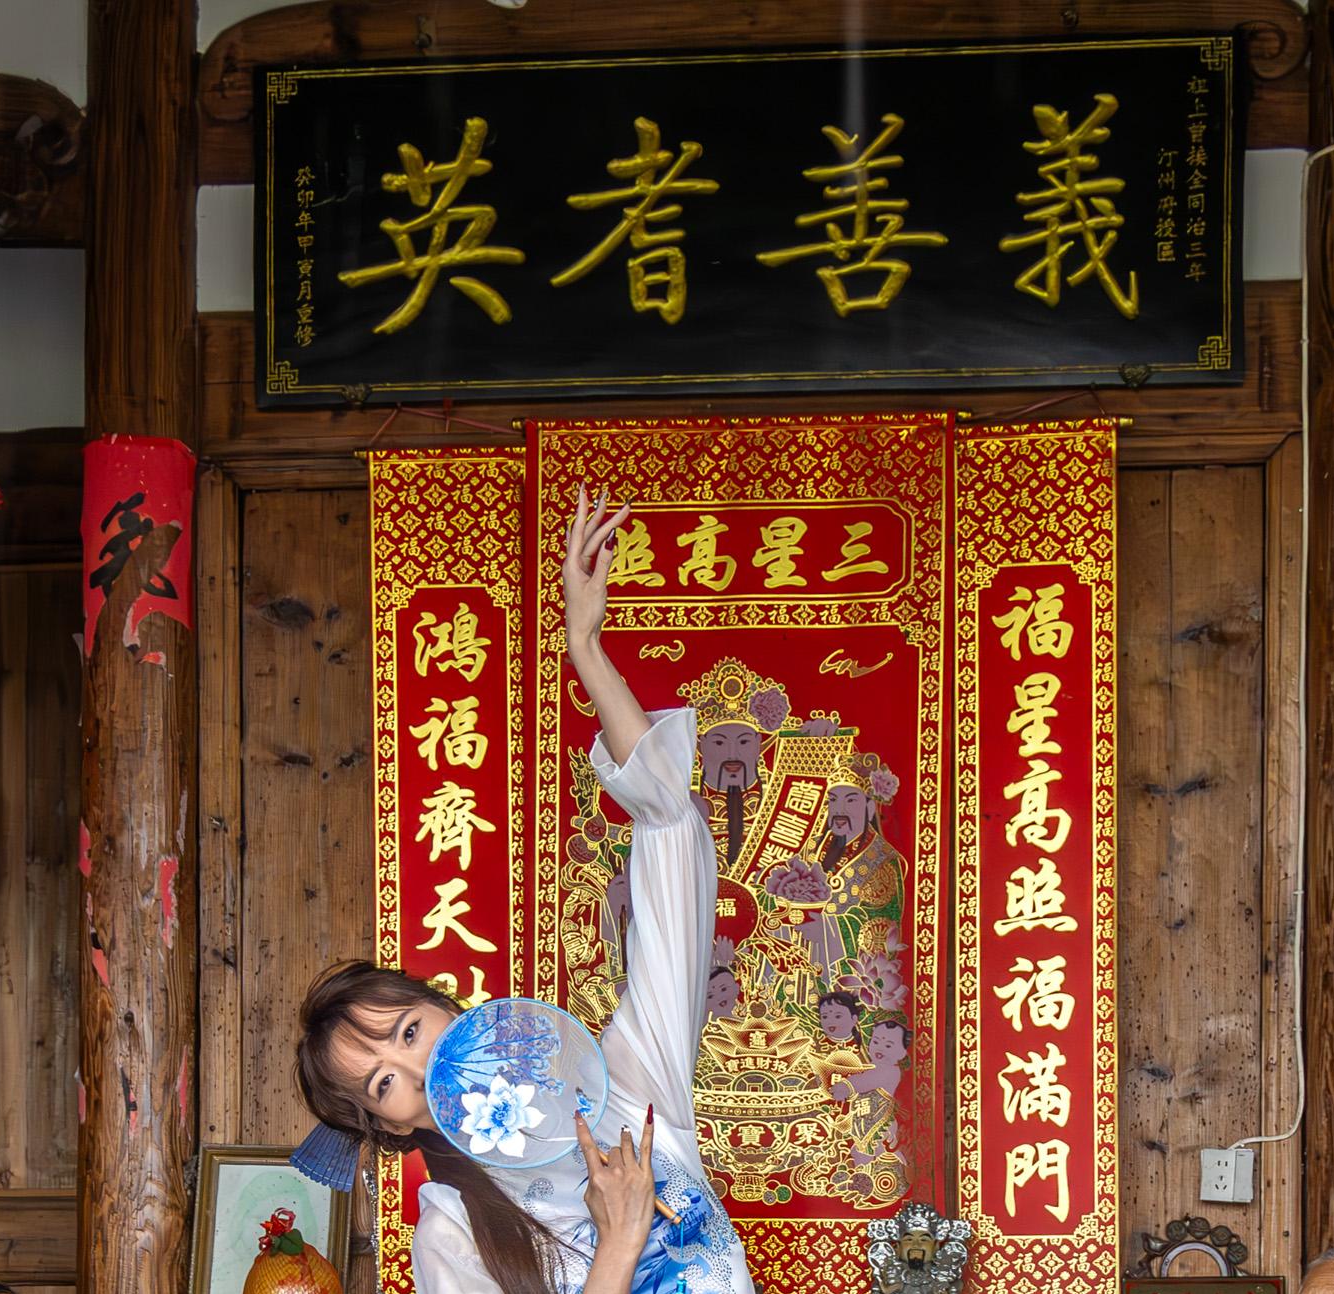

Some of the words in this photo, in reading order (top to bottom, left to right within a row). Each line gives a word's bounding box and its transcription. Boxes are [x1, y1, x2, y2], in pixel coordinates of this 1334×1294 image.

[294, 165, 316, 347] 癸卯年甲寅月重修
[609, 515, 889, 592] 三星高照
[992, 583, 1079, 1224] 福星高照福滿門
[725, 1056, 789, 1074] 招財進寶
